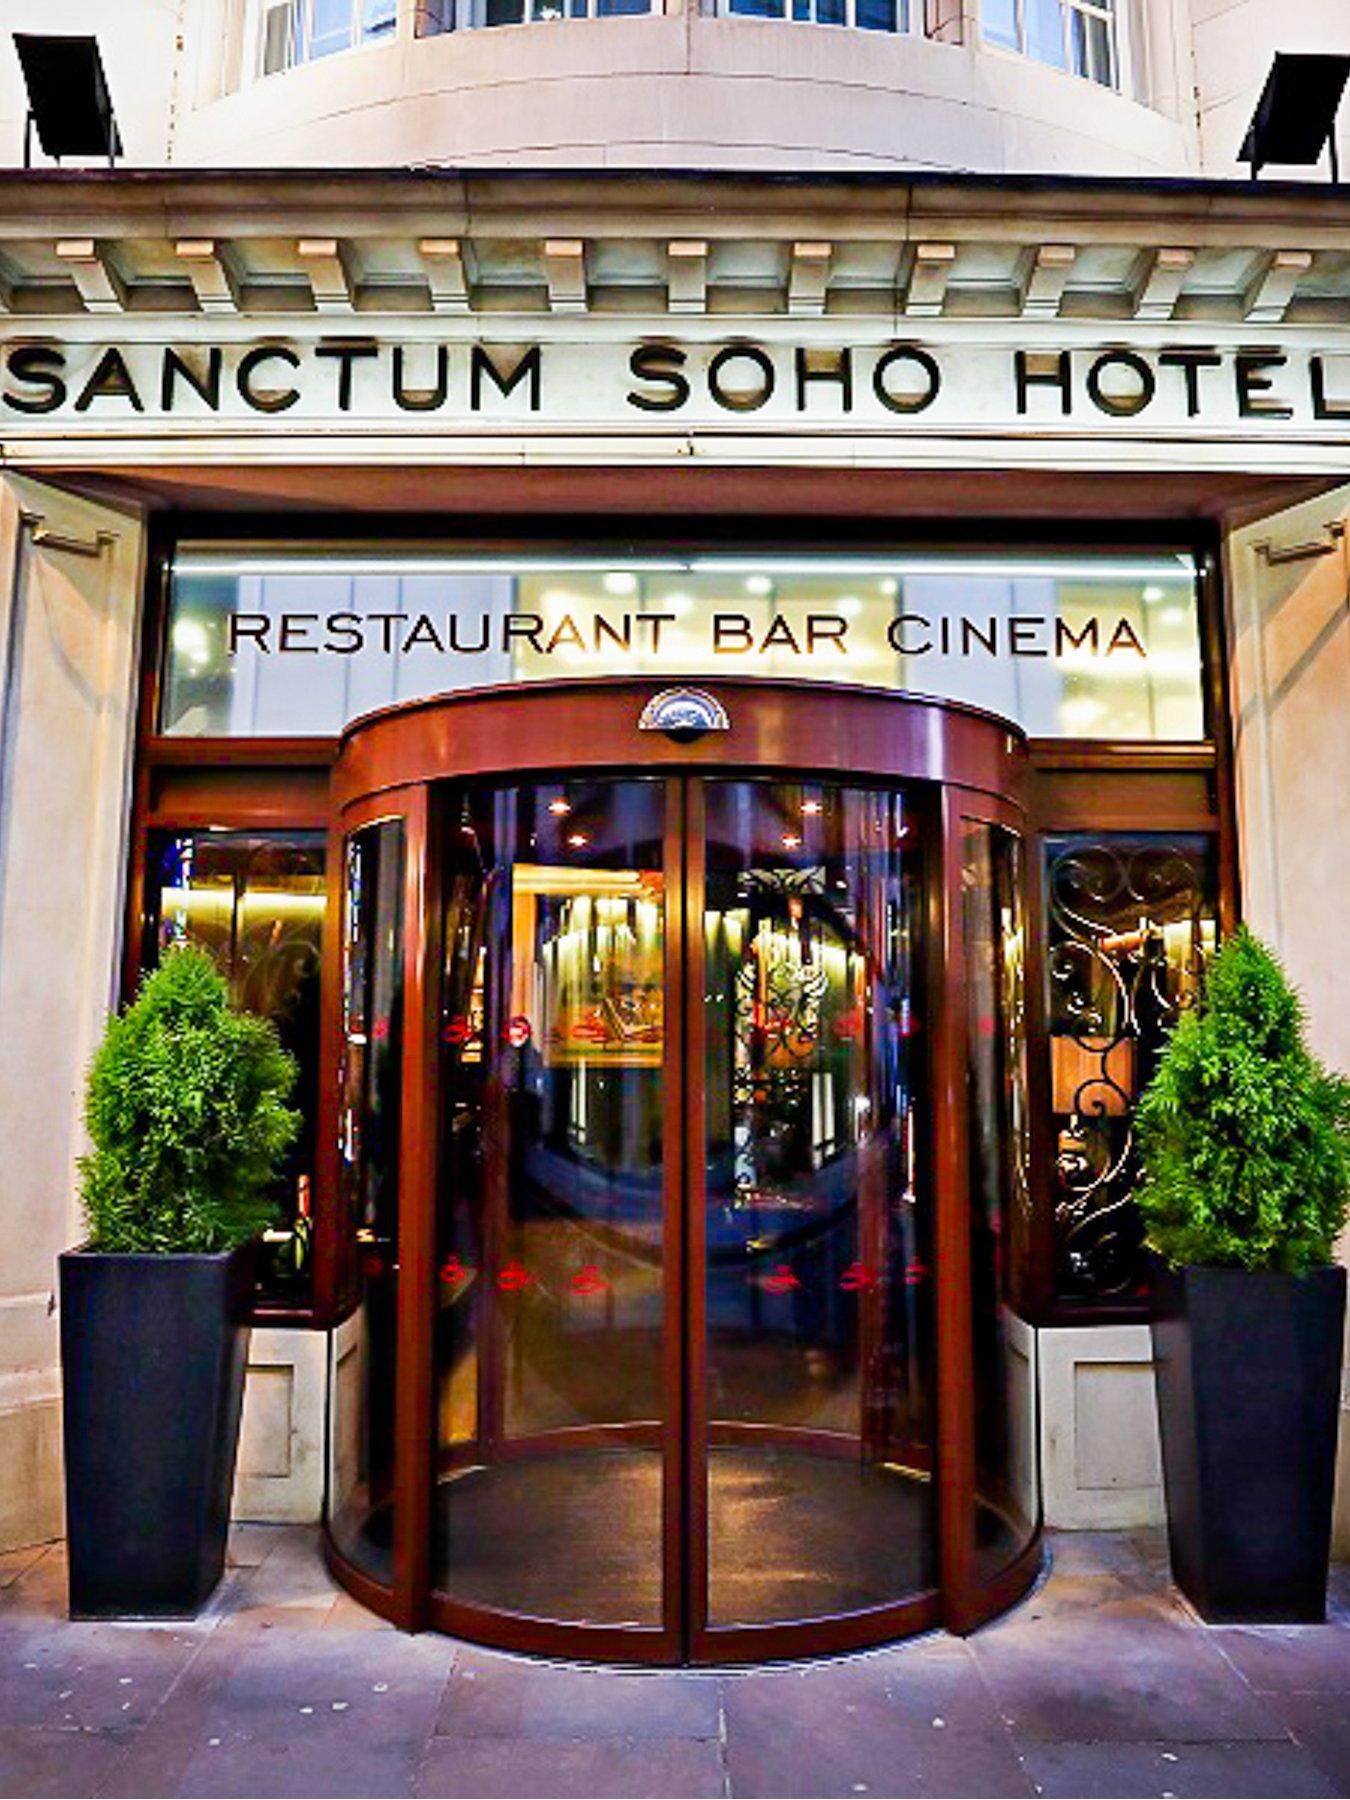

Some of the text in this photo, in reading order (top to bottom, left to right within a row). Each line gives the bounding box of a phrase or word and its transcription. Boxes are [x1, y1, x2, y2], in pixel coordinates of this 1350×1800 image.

[3, 345, 1350, 419] SANCTUM SOHO HOTEL
[229, 614, 1148, 657] RESTAURANT BAR CINEMA
